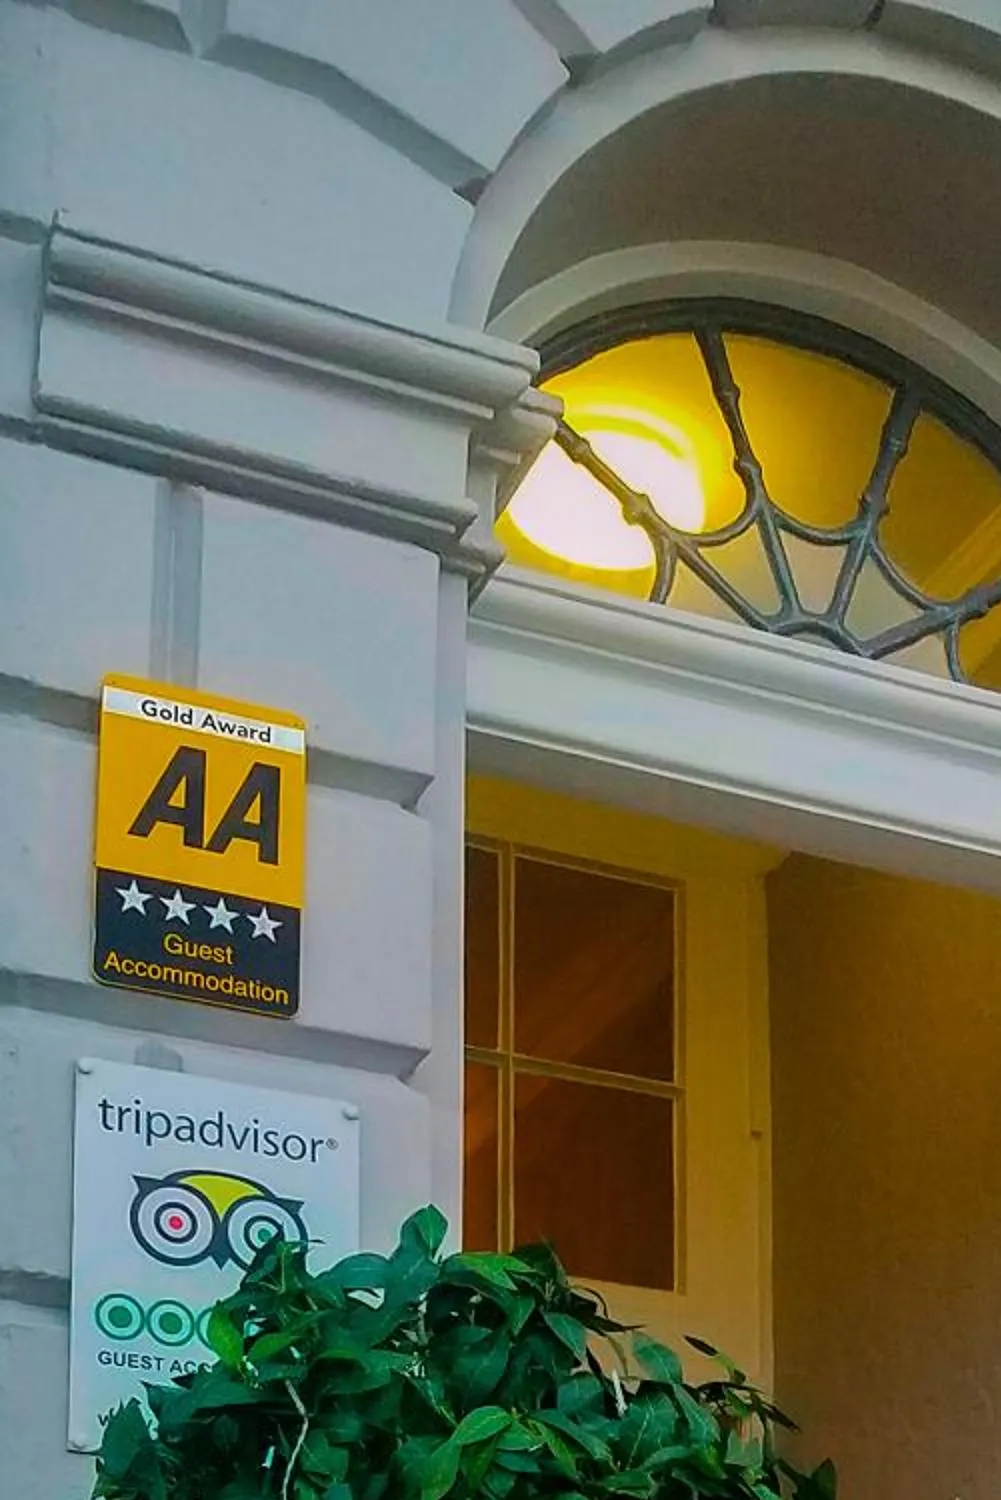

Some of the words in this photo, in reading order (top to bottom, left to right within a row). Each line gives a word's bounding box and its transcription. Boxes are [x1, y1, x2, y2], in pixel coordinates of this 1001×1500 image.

[141, 699, 193, 726] Gold
[201, 713, 272, 744] Award
[127, 745, 281, 866] AA
[163, 932, 233, 966] Guest
[104, 951, 289, 1005] Accommodation
[97, 1351, 165, 1371] GUEST
